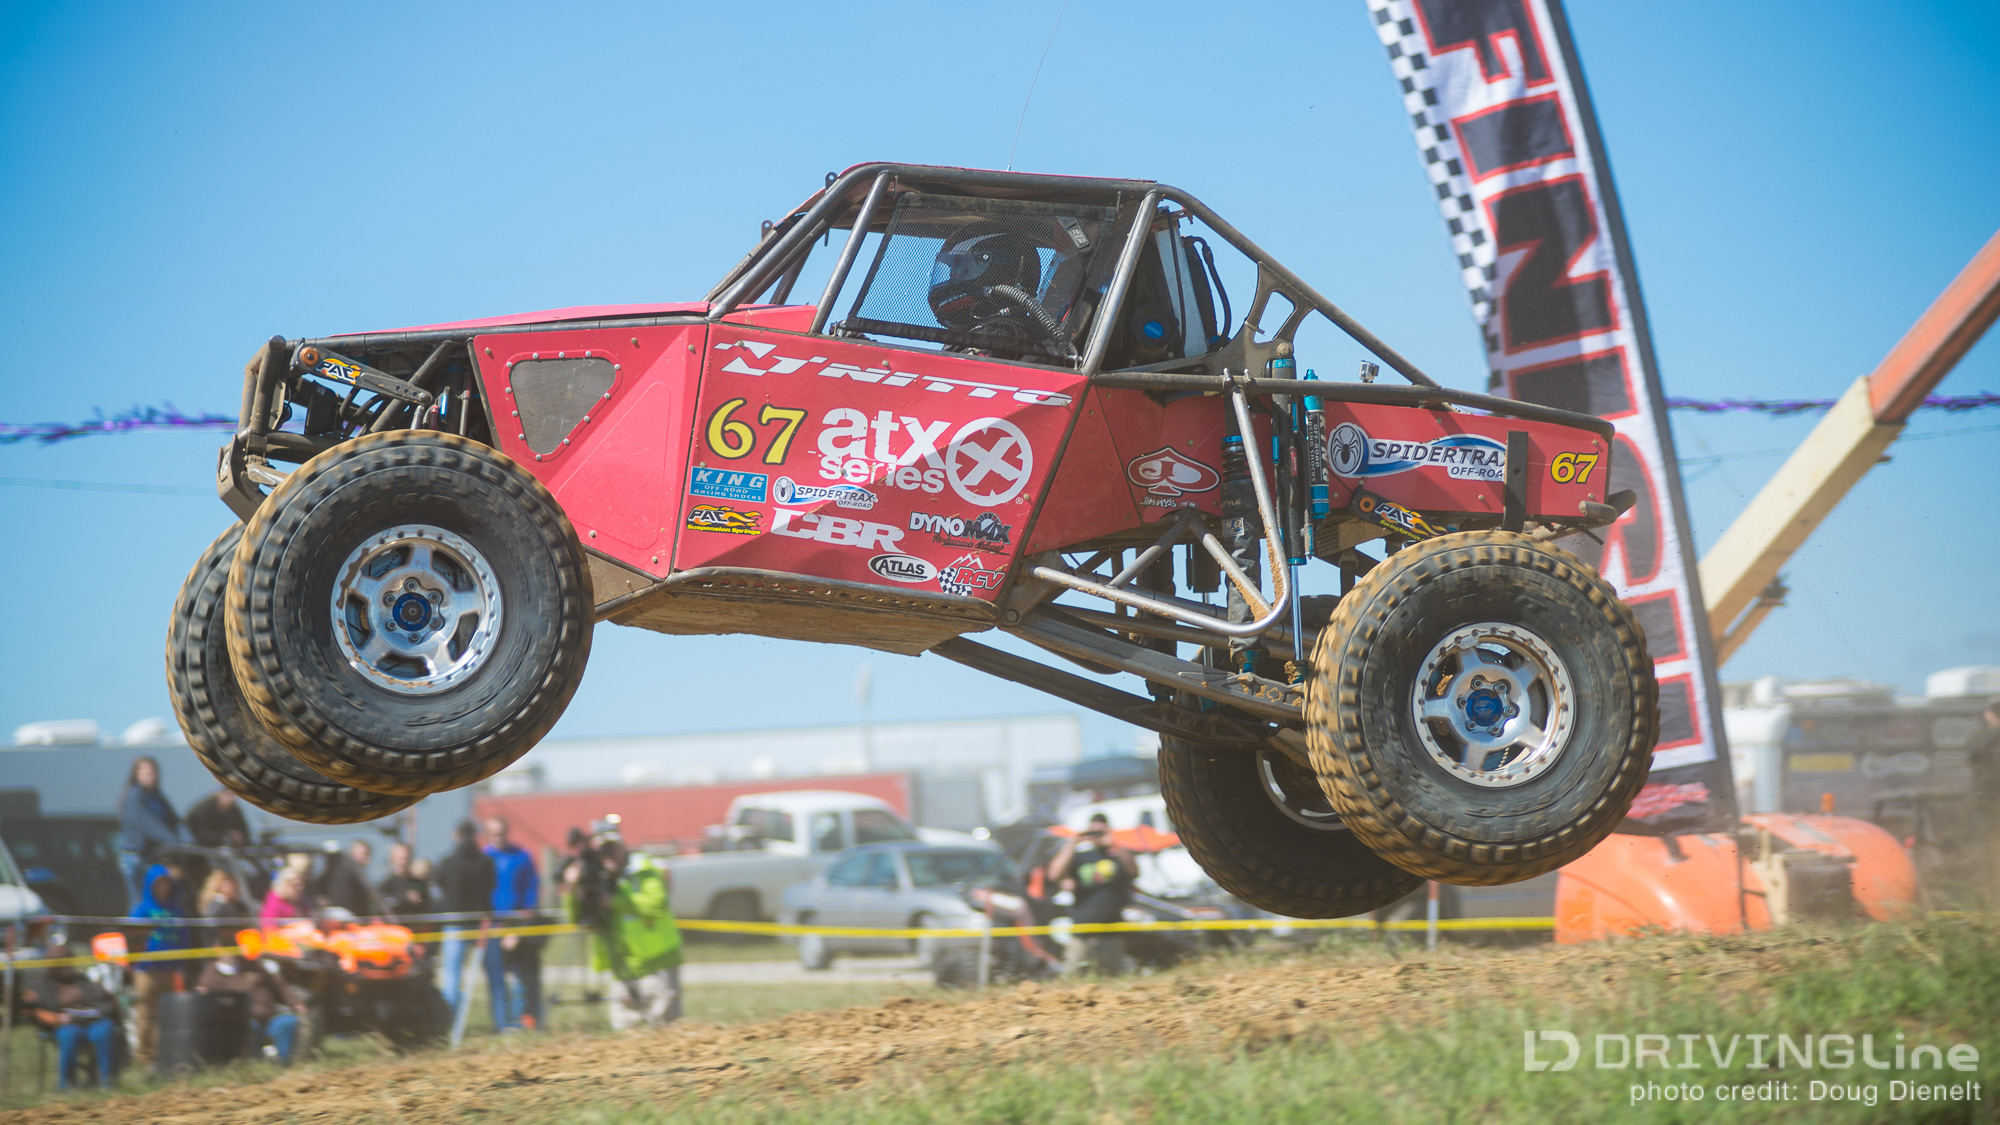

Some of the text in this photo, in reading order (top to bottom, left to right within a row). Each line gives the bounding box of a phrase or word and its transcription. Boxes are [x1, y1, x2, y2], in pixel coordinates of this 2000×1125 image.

[315, 360, 356, 382] PAC
[817, 362, 1073, 407] NITTO
[705, 397, 808, 465] 67
[817, 407, 951, 469] atx
[818, 453, 945, 494] series
[1451, 466, 1504, 478] OFF-ROA
[1551, 450, 1599, 484] 67
[695, 470, 765, 488] KING
[694, 489, 726, 497] RACING
[704, 485, 748, 494] OFF-ROAD
[797, 486, 874, 503] SPIDERTRAX
[838, 500, 873, 509] OFF-ROAD
[688, 508, 729, 524] PAC
[1375, 503, 1414, 528] PAC
[687, 524, 761, 536] Suspension Springs
[880, 558, 926, 576] ATLAS
[952, 566, 1005, 590] RCV
